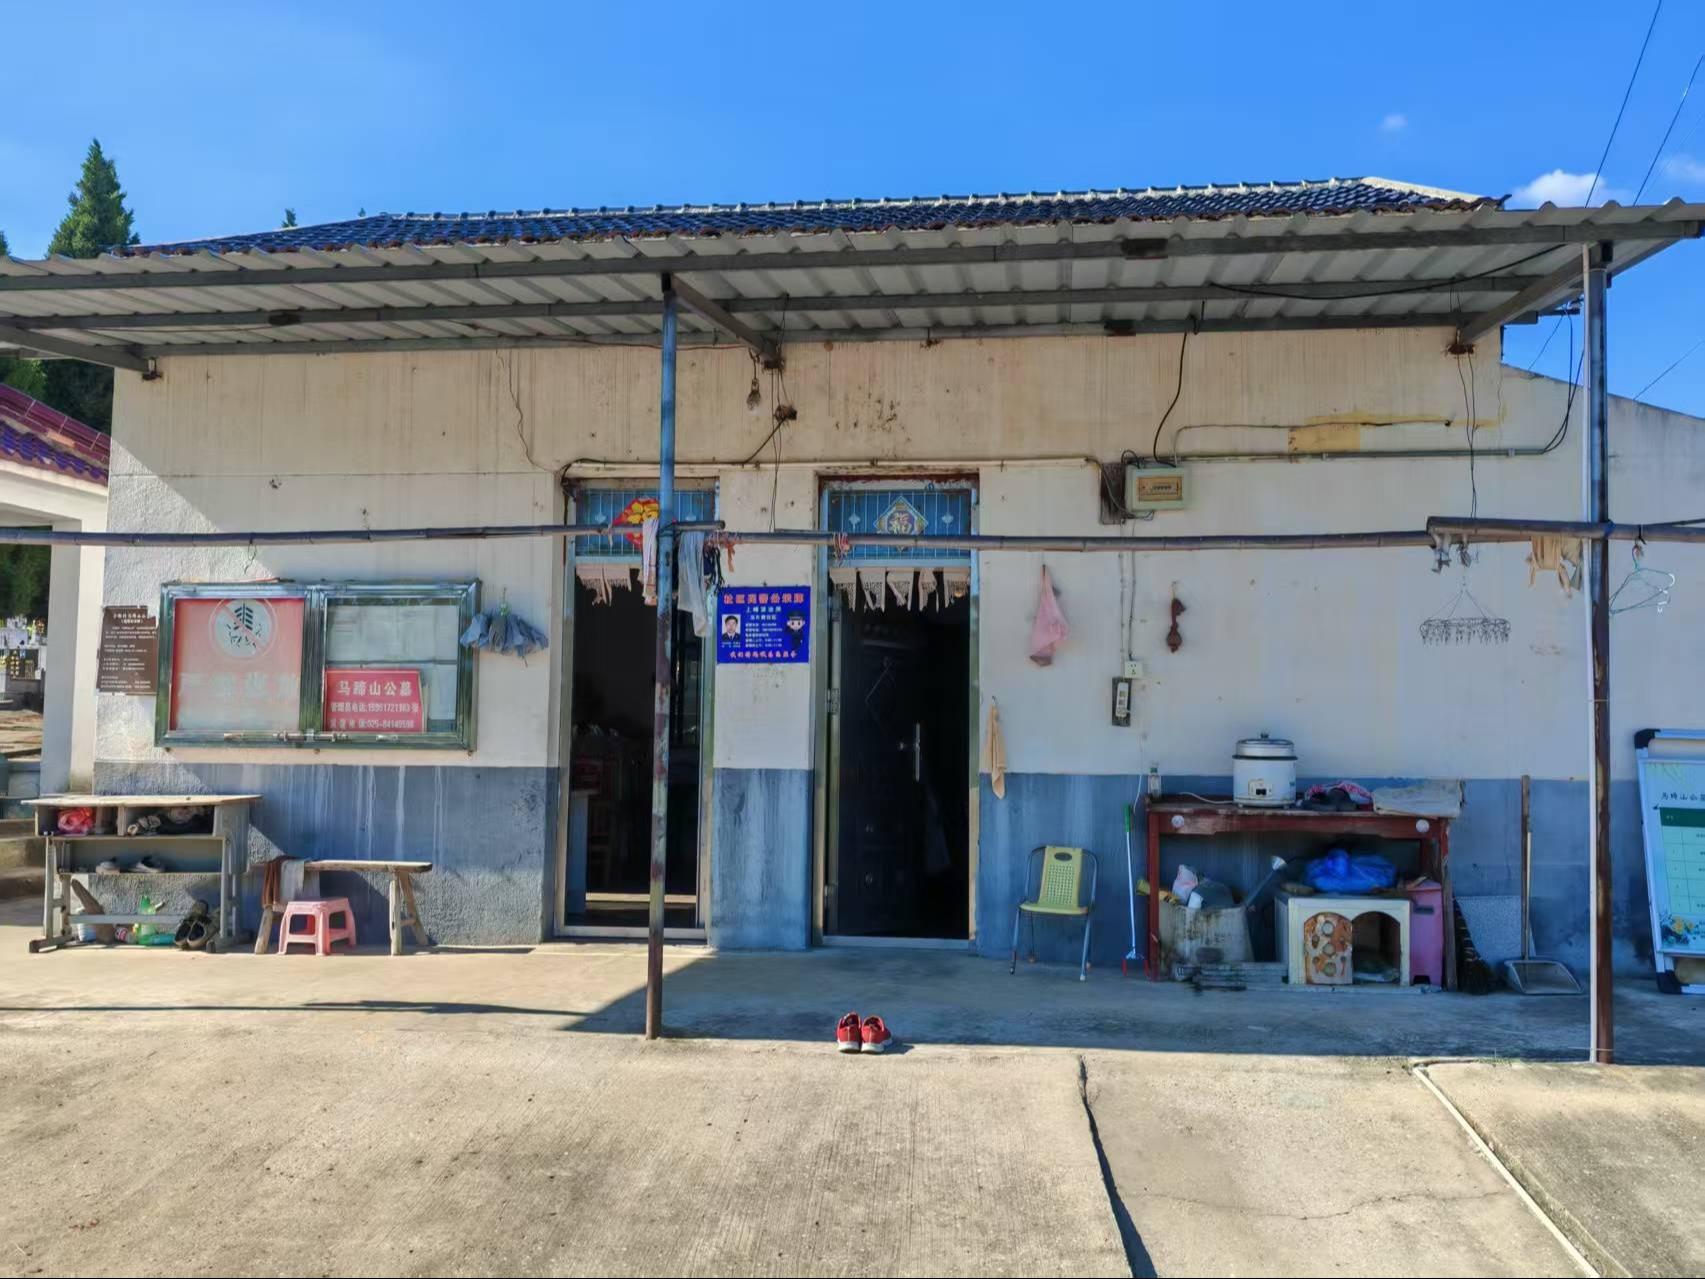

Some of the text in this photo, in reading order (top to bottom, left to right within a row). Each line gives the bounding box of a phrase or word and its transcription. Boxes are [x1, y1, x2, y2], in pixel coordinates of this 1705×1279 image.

[337, 680, 412, 696] 马蹄山公墓
